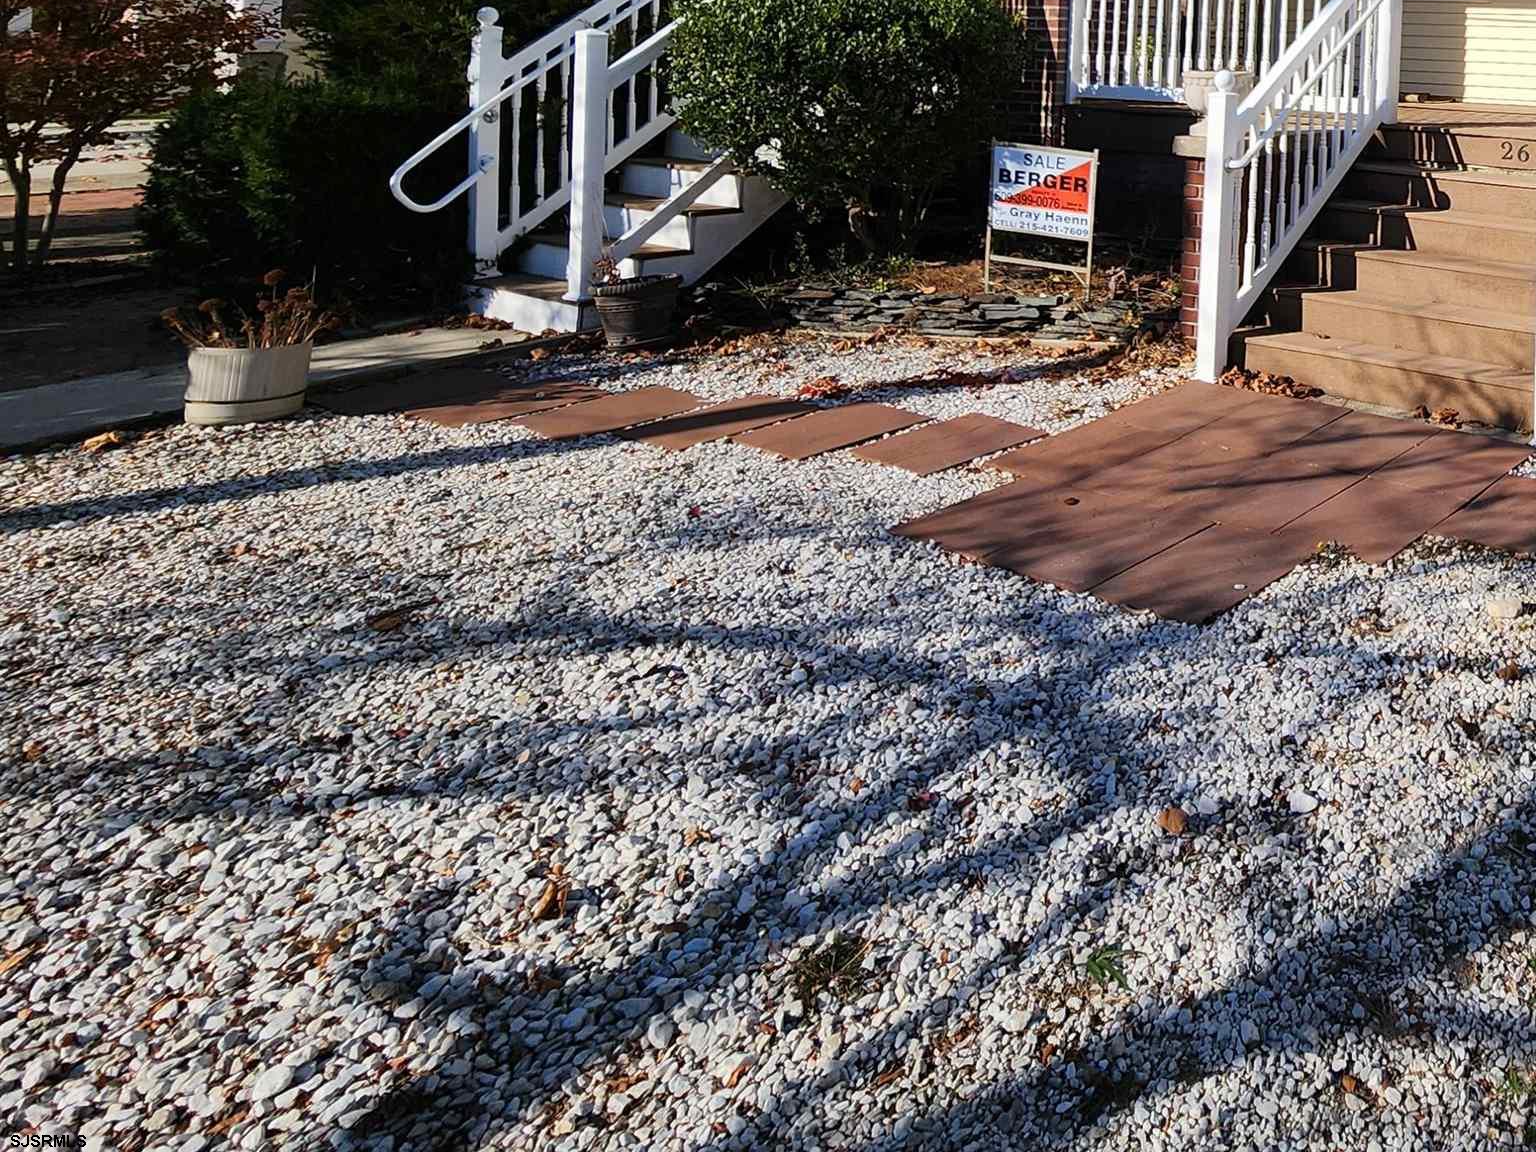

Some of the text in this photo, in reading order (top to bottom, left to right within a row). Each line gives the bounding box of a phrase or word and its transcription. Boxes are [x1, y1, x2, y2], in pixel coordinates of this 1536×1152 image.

[1023, 152, 1067, 170] SALE
[1500, 140, 1530, 163] 26
[998, 168, 1088, 193] BERGER
[994, 190, 1061, 209] 609-399-0076
[1009, 207, 1088, 226] Gray Haenn
[1019, 221, 1089, 237] 215-421-7609
